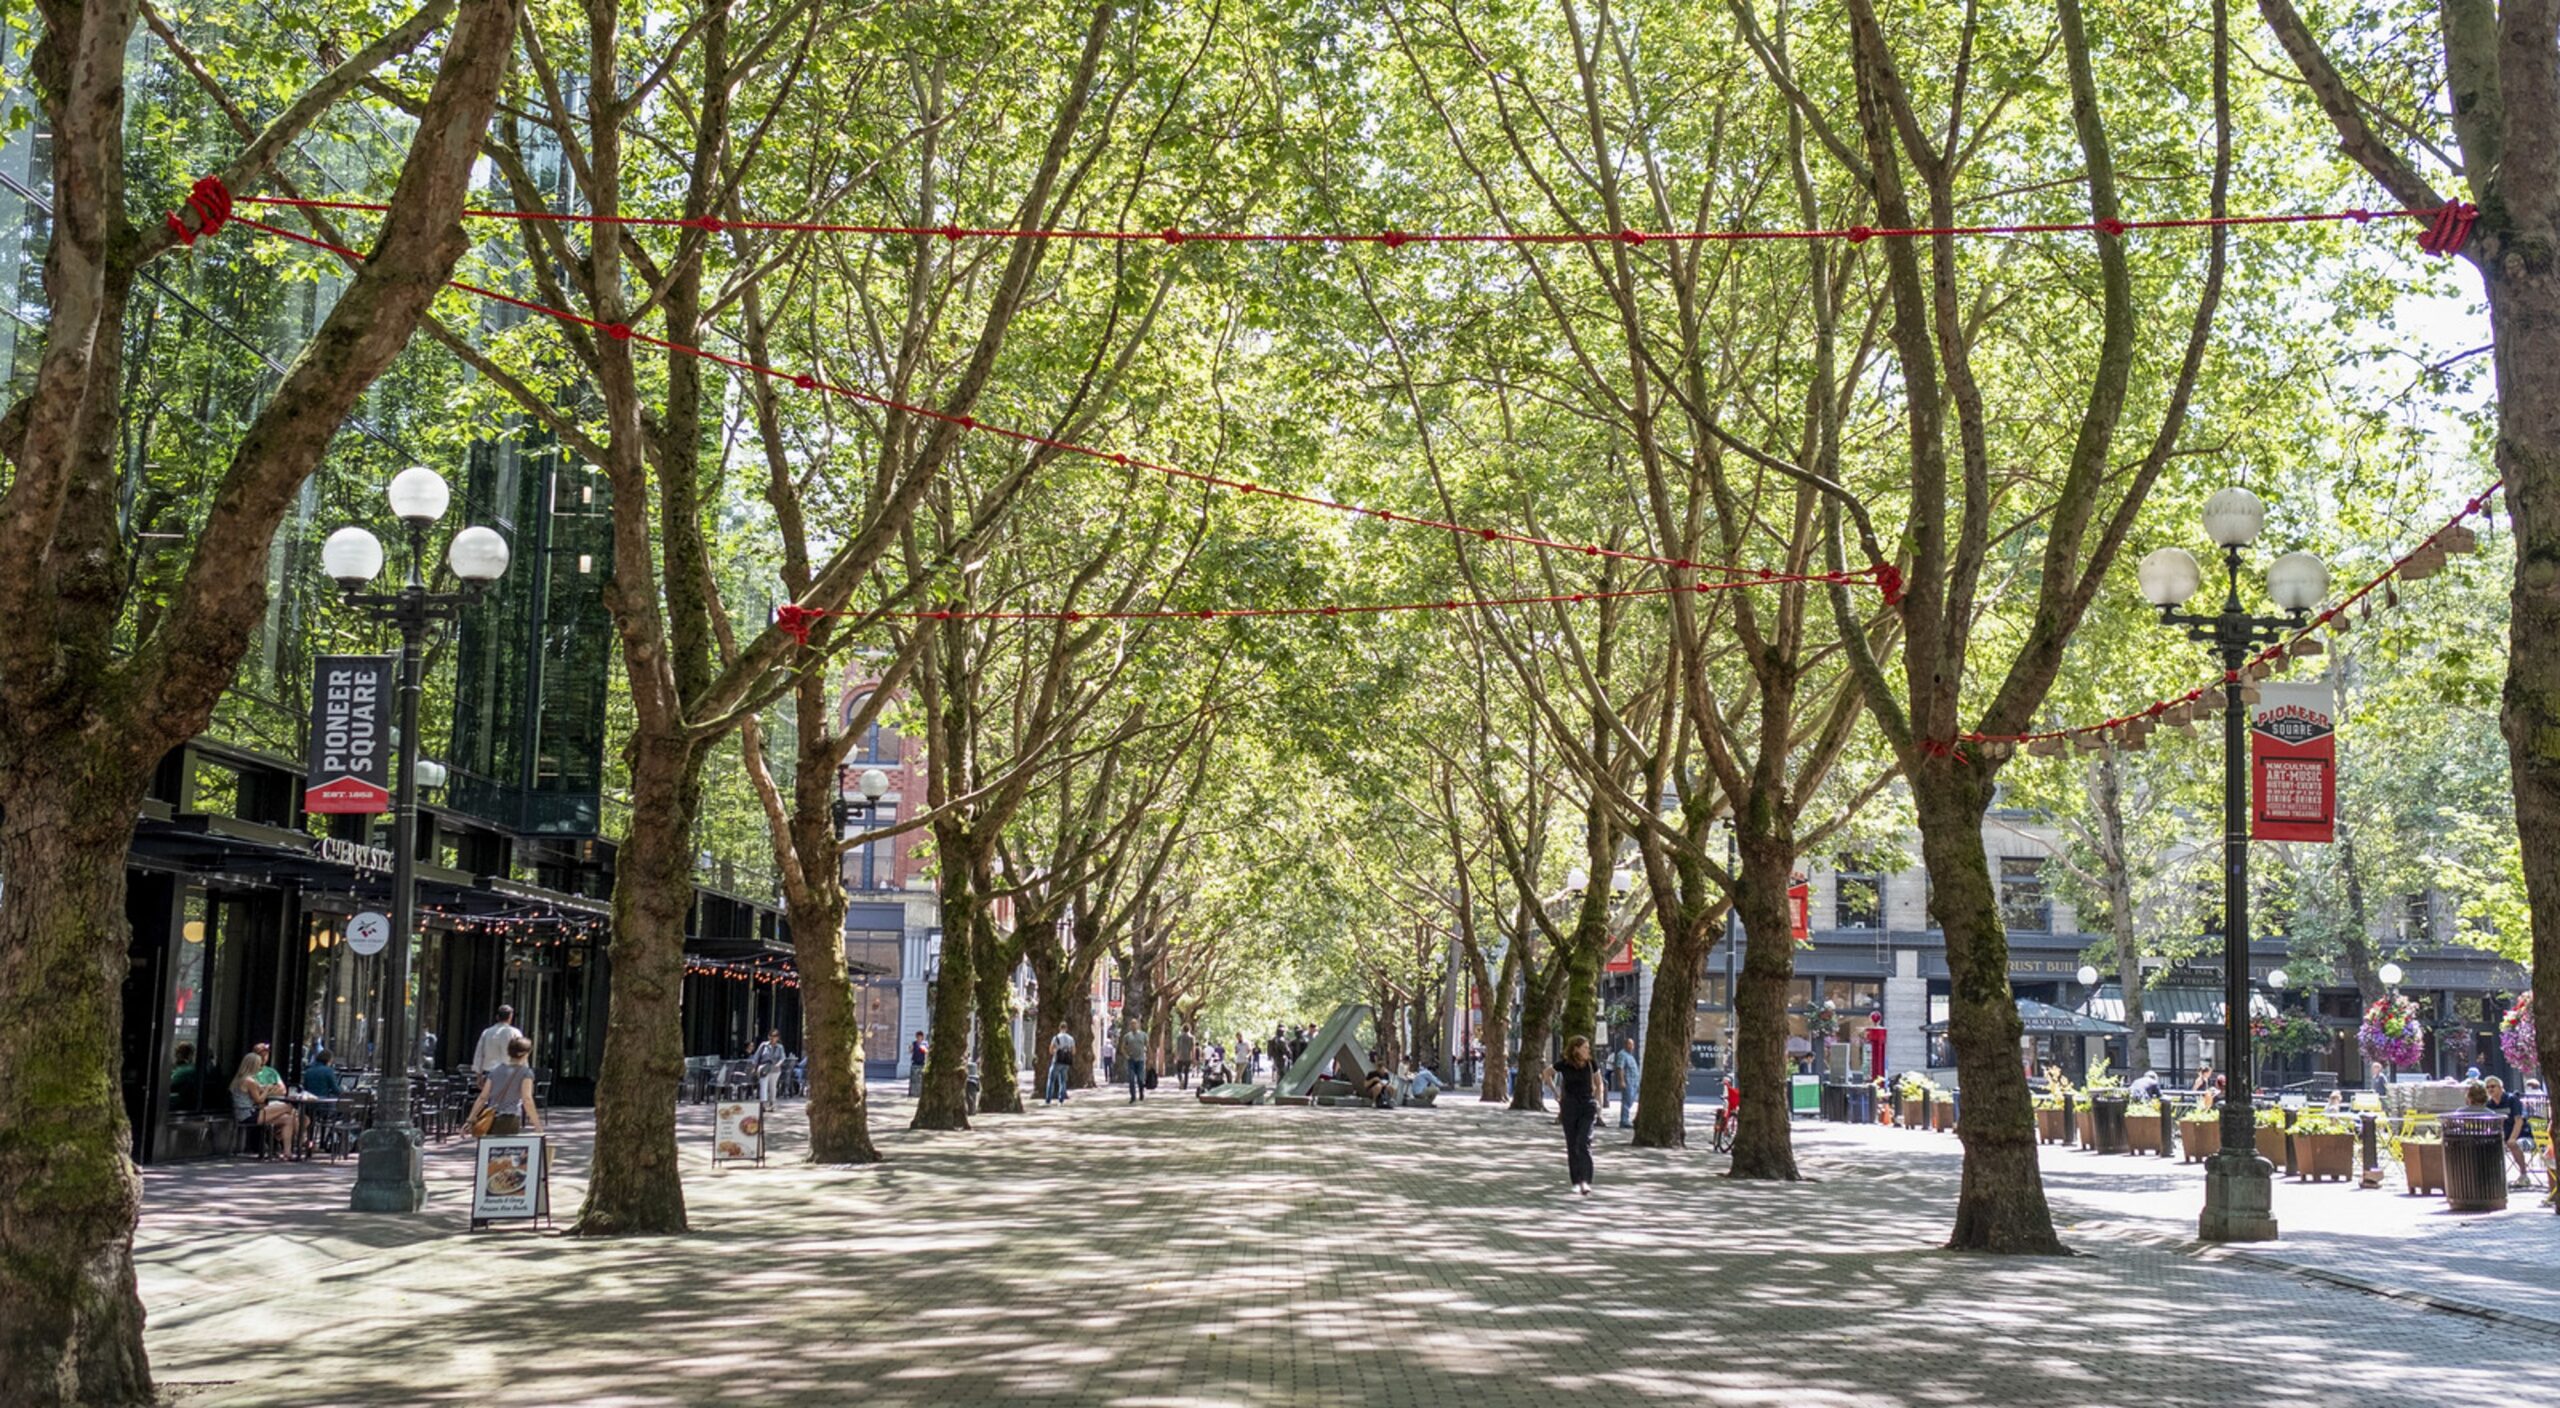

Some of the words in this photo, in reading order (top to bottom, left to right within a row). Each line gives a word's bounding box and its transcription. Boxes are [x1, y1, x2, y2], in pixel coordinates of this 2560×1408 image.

[323, 669, 352, 773] PIONEER
[350, 670, 377, 772] SQUARE
[2257, 704, 2329, 729] PIONEER
[2272, 724, 2313, 736] SQUARE
[322, 836, 370, 868] CHERRY
[2008, 961, 2042, 972] RUST
